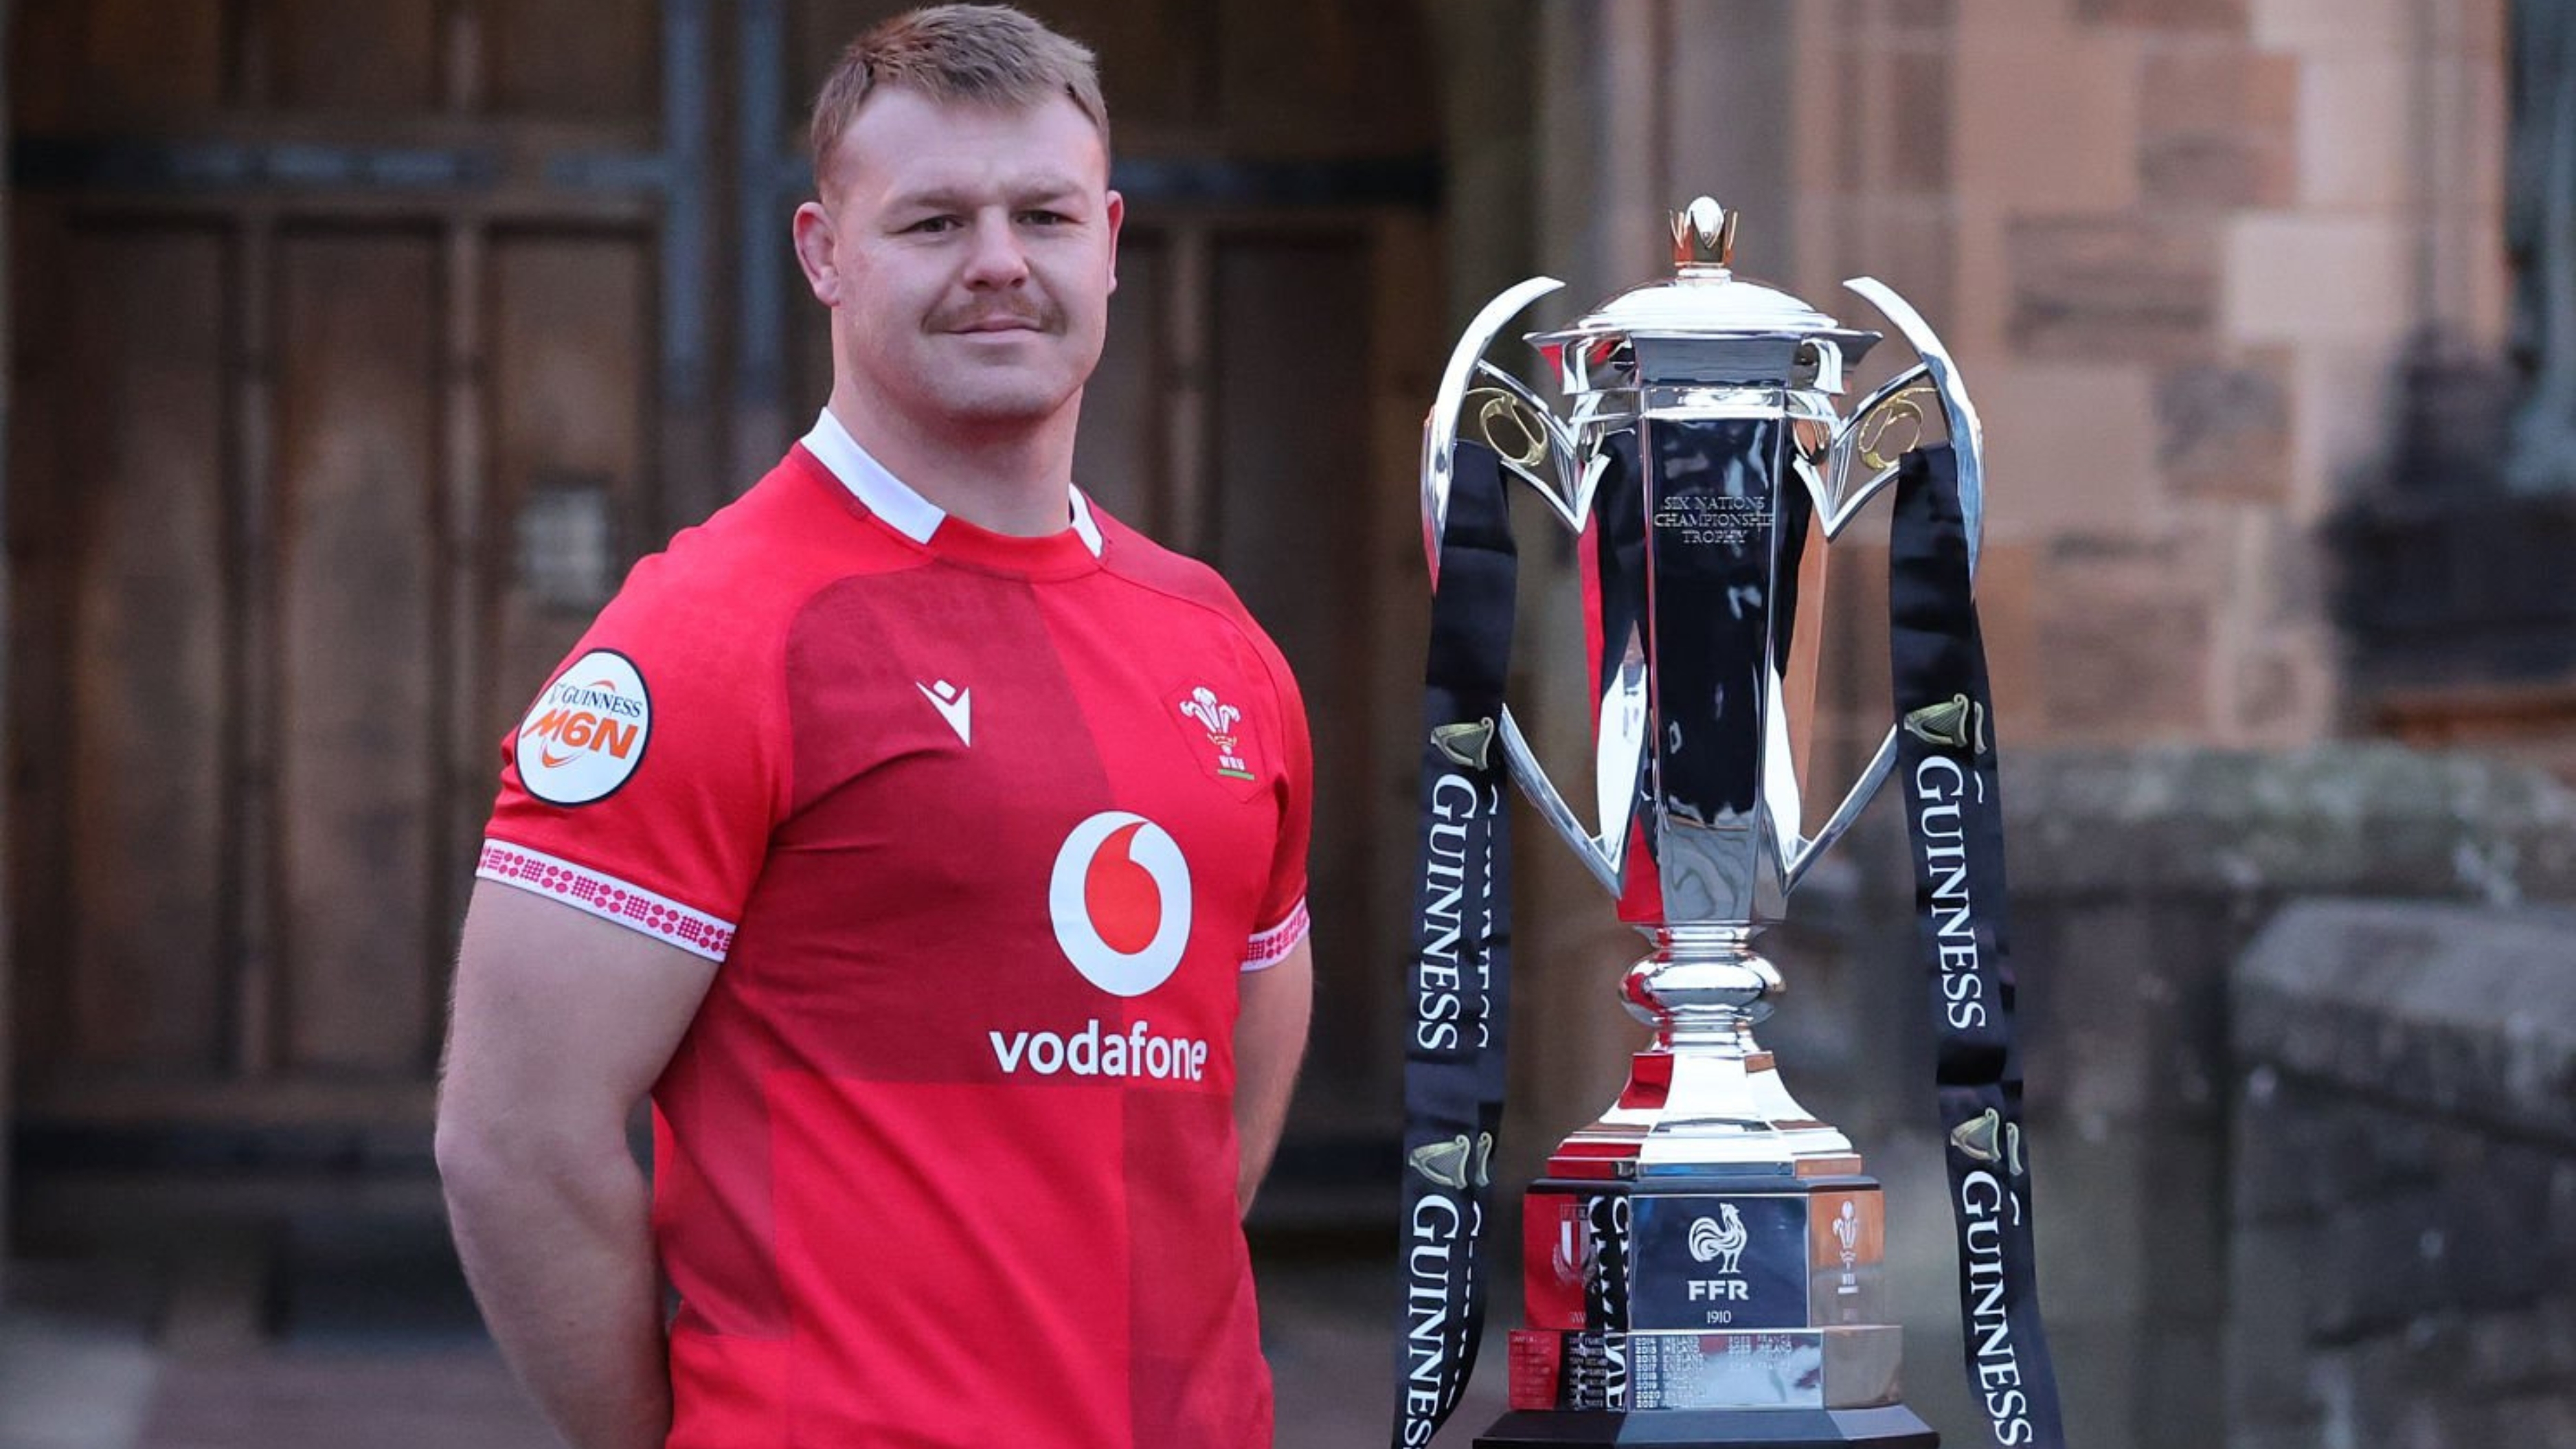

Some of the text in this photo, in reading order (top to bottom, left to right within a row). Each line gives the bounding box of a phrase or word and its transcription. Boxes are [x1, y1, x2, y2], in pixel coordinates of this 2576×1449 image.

[1664, 496, 1765, 510] SIX NATIONS
[1682, 530, 1748, 543] TROPHY
[563, 686, 642, 718] GUINNESS
[1916, 755, 1986, 1029] GUINNESS
[1417, 774, 1478, 1050] GUINNESS
[989, 1019, 1208, 1081] vodafone
[1688, 1280, 1749, 1301] FFR
[1404, 1194, 1460, 1449] GUINNES
[1706, 1310, 1732, 1324] 1910
[1962, 1171, 2032, 1446] GUINNESS
[1636, 1391, 1660, 1400] 2020
